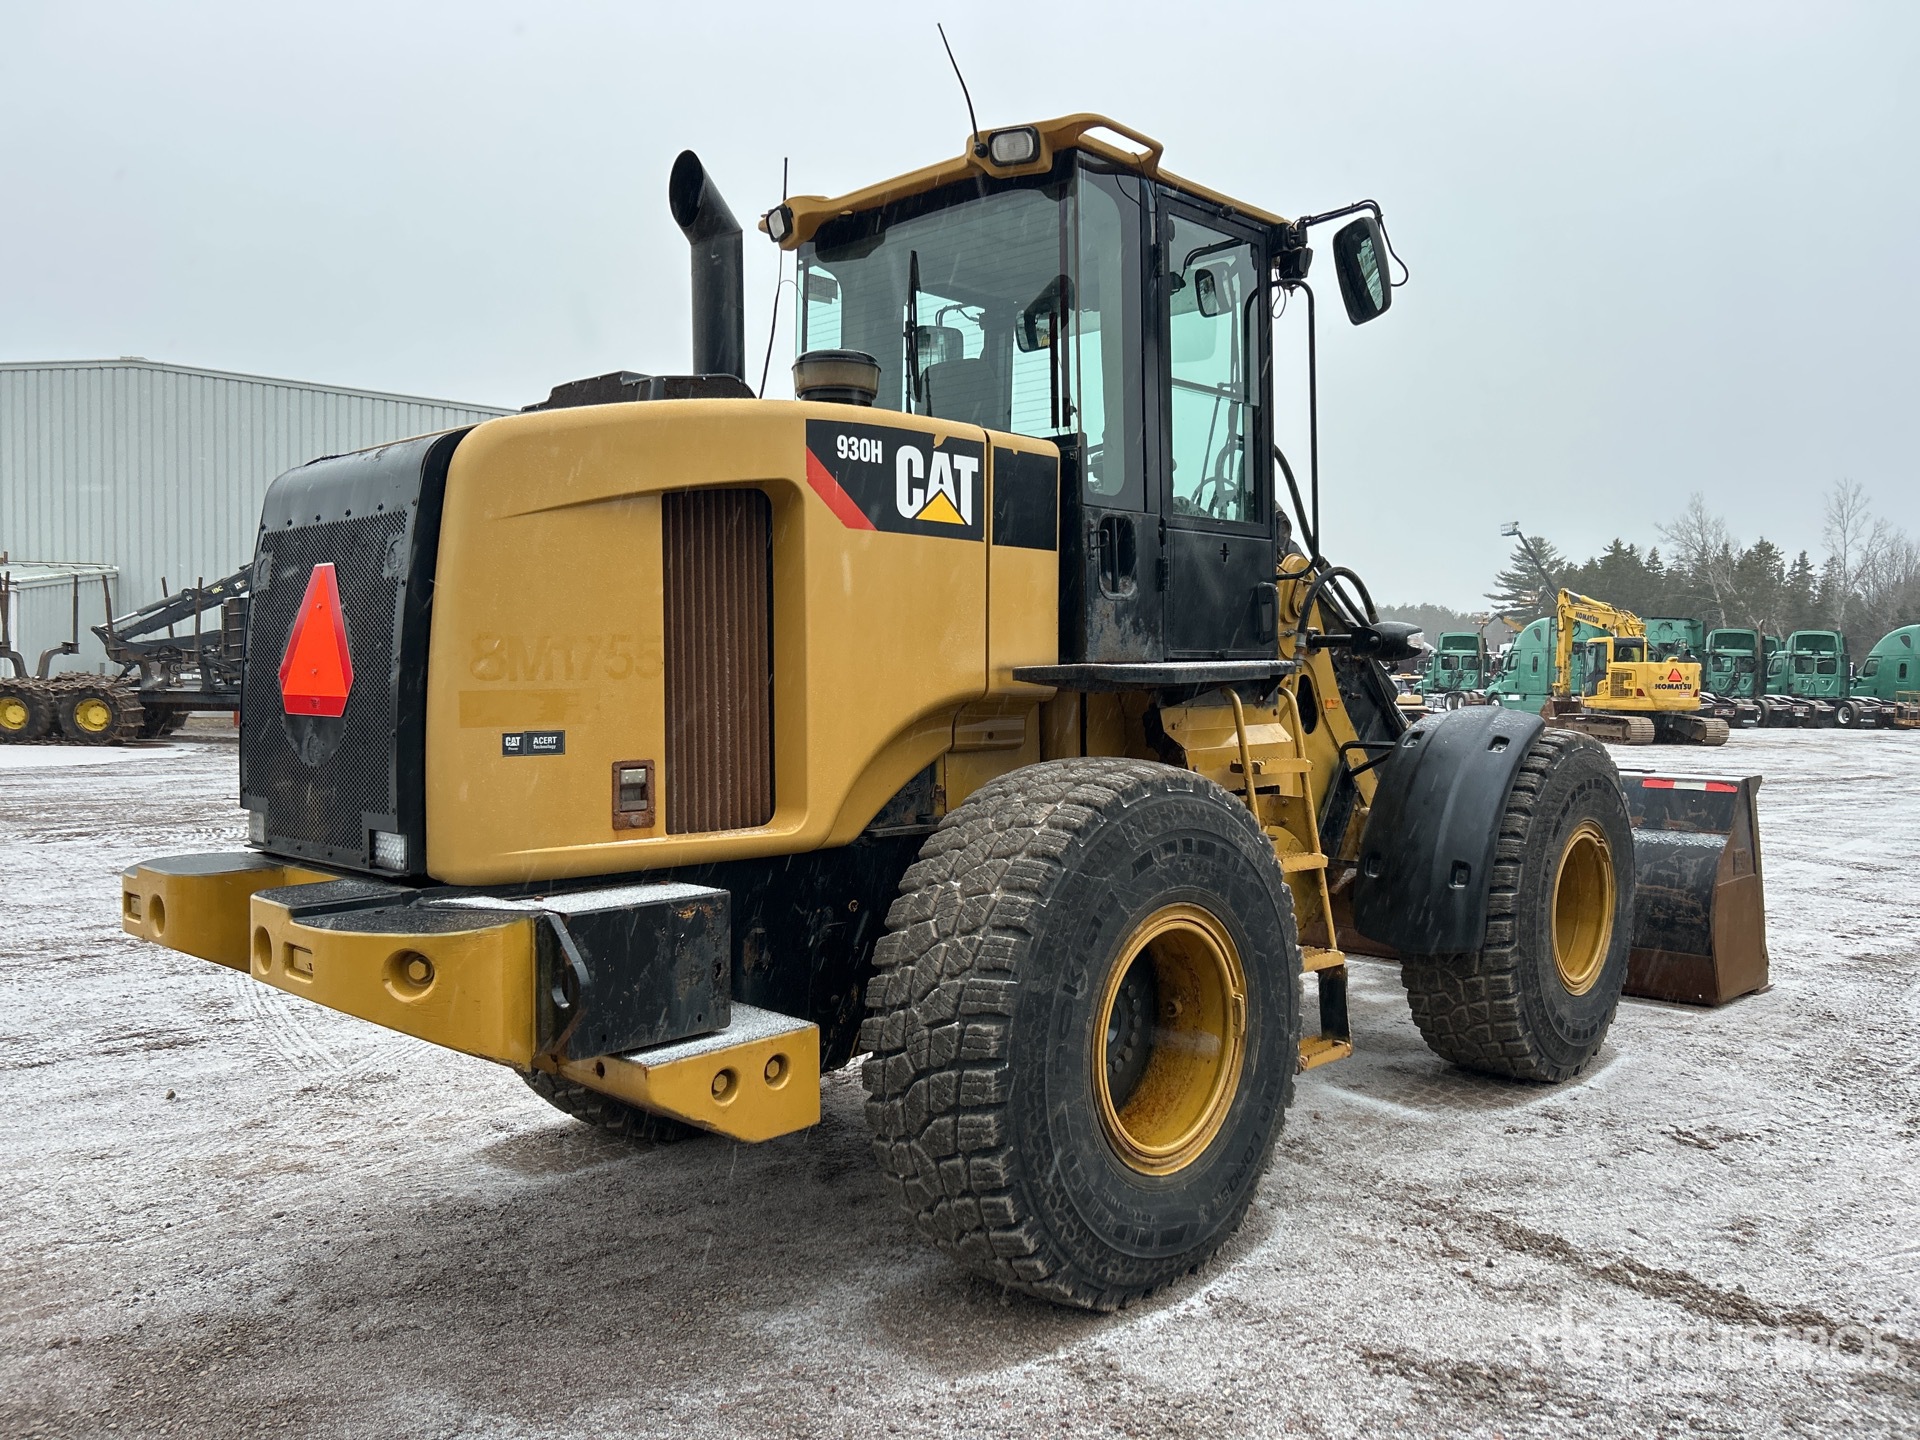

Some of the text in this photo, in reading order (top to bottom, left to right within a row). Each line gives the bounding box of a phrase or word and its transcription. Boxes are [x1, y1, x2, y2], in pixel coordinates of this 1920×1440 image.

[837, 434, 883, 464] 930H
[896, 445, 979, 526] CAT
[1654, 682, 1692, 690] KOMATSU
[505, 736, 521, 747] CAT
[532, 736, 558, 745] ACERT
